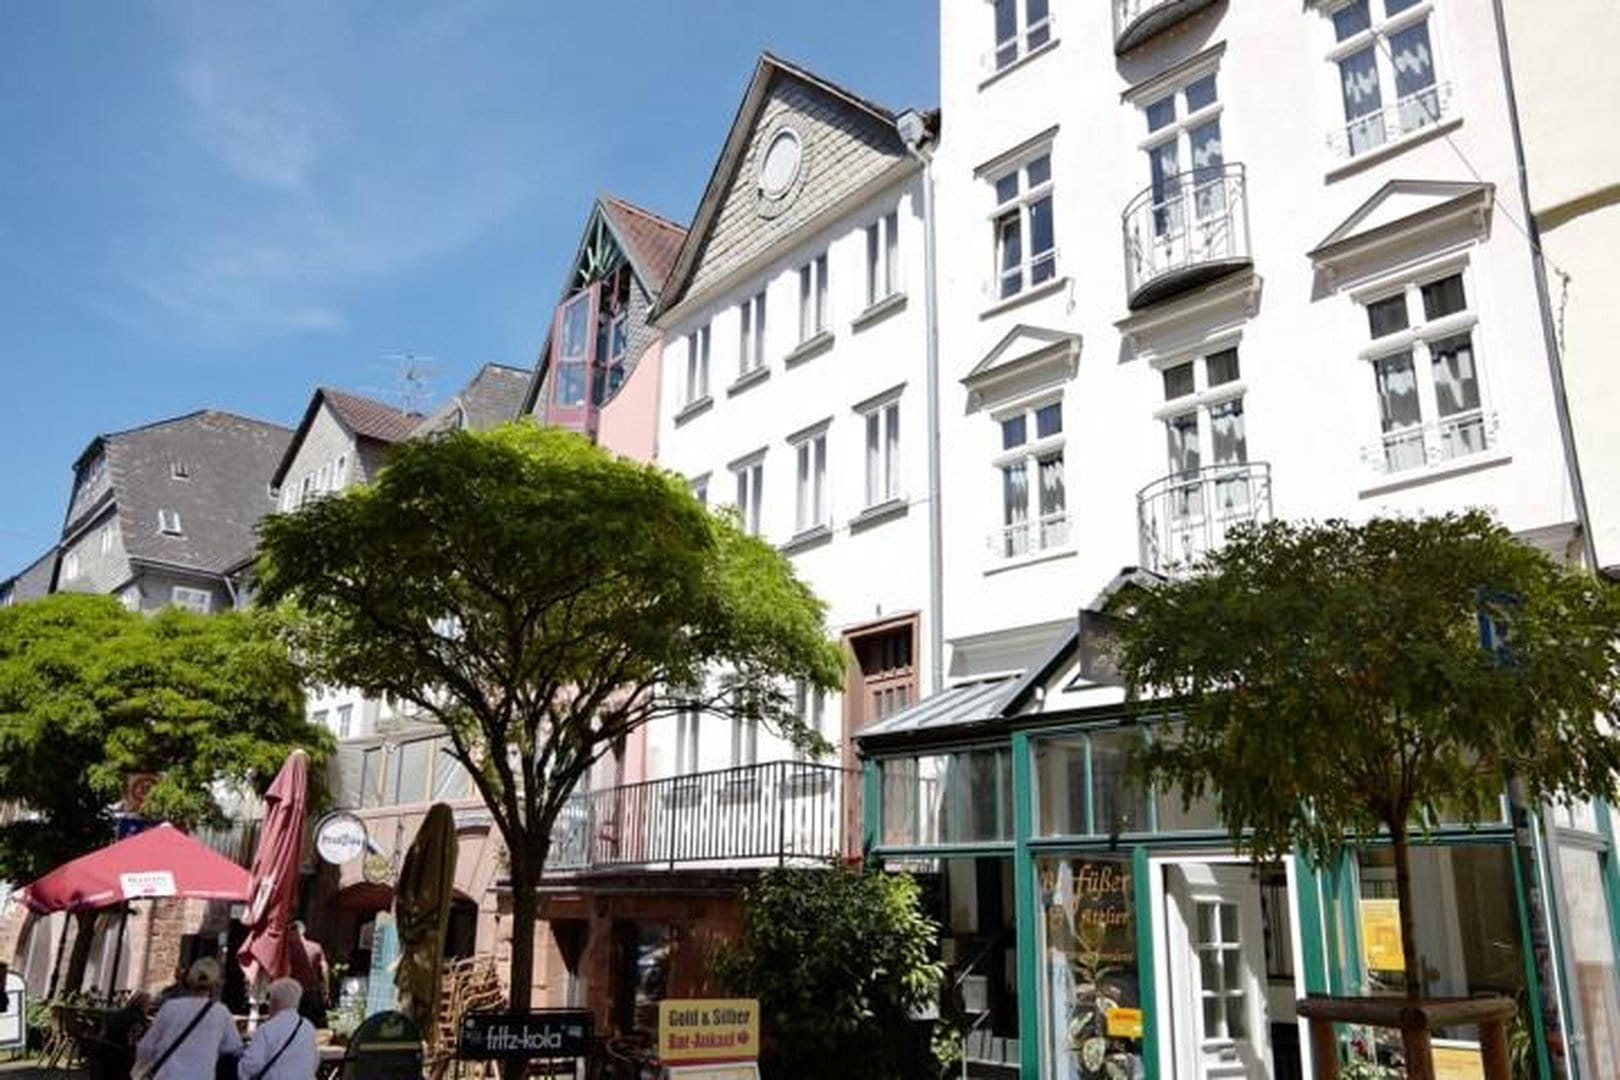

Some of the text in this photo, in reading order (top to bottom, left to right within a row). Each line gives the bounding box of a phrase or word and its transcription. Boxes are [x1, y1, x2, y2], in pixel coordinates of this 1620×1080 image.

[669, 1008, 699, 1027] Gold
[712, 1007, 751, 1026] Silber
[486, 1024, 562, 1051] fritz-kola
